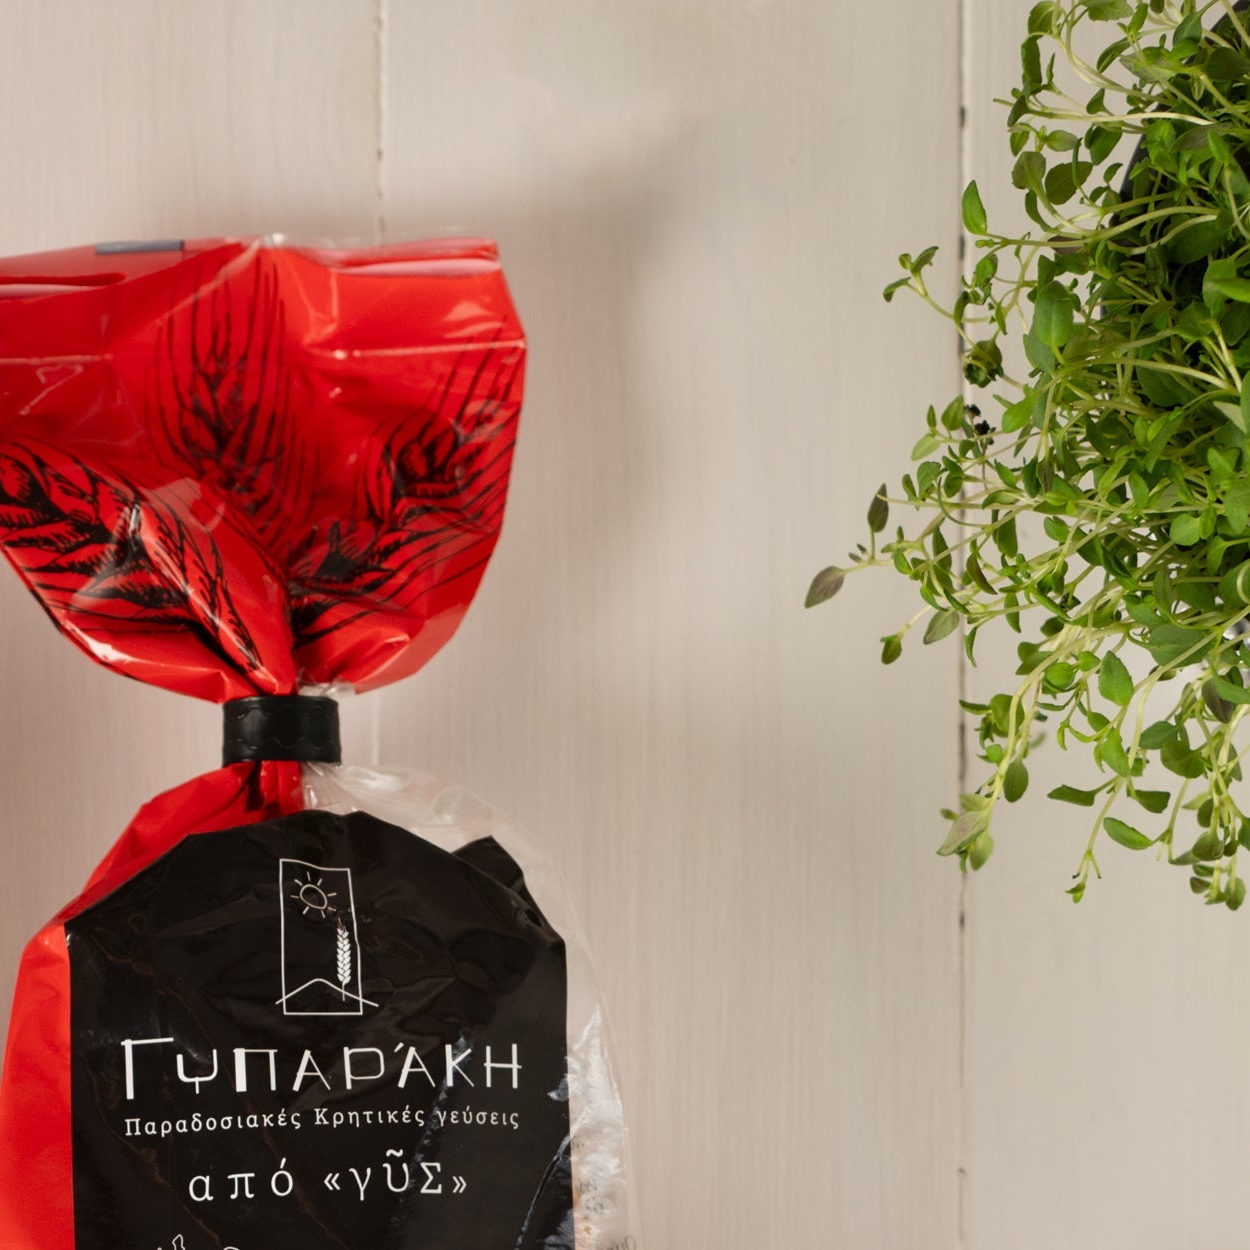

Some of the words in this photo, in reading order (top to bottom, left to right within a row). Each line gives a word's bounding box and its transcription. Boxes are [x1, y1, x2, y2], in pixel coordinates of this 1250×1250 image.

[124, 1107, 302, 1137] Παραδοσιακές
[314, 1106, 426, 1131] Κρητικές
[436, 1108, 520, 1129] γεύσεις
[188, 1157, 295, 1202] από
